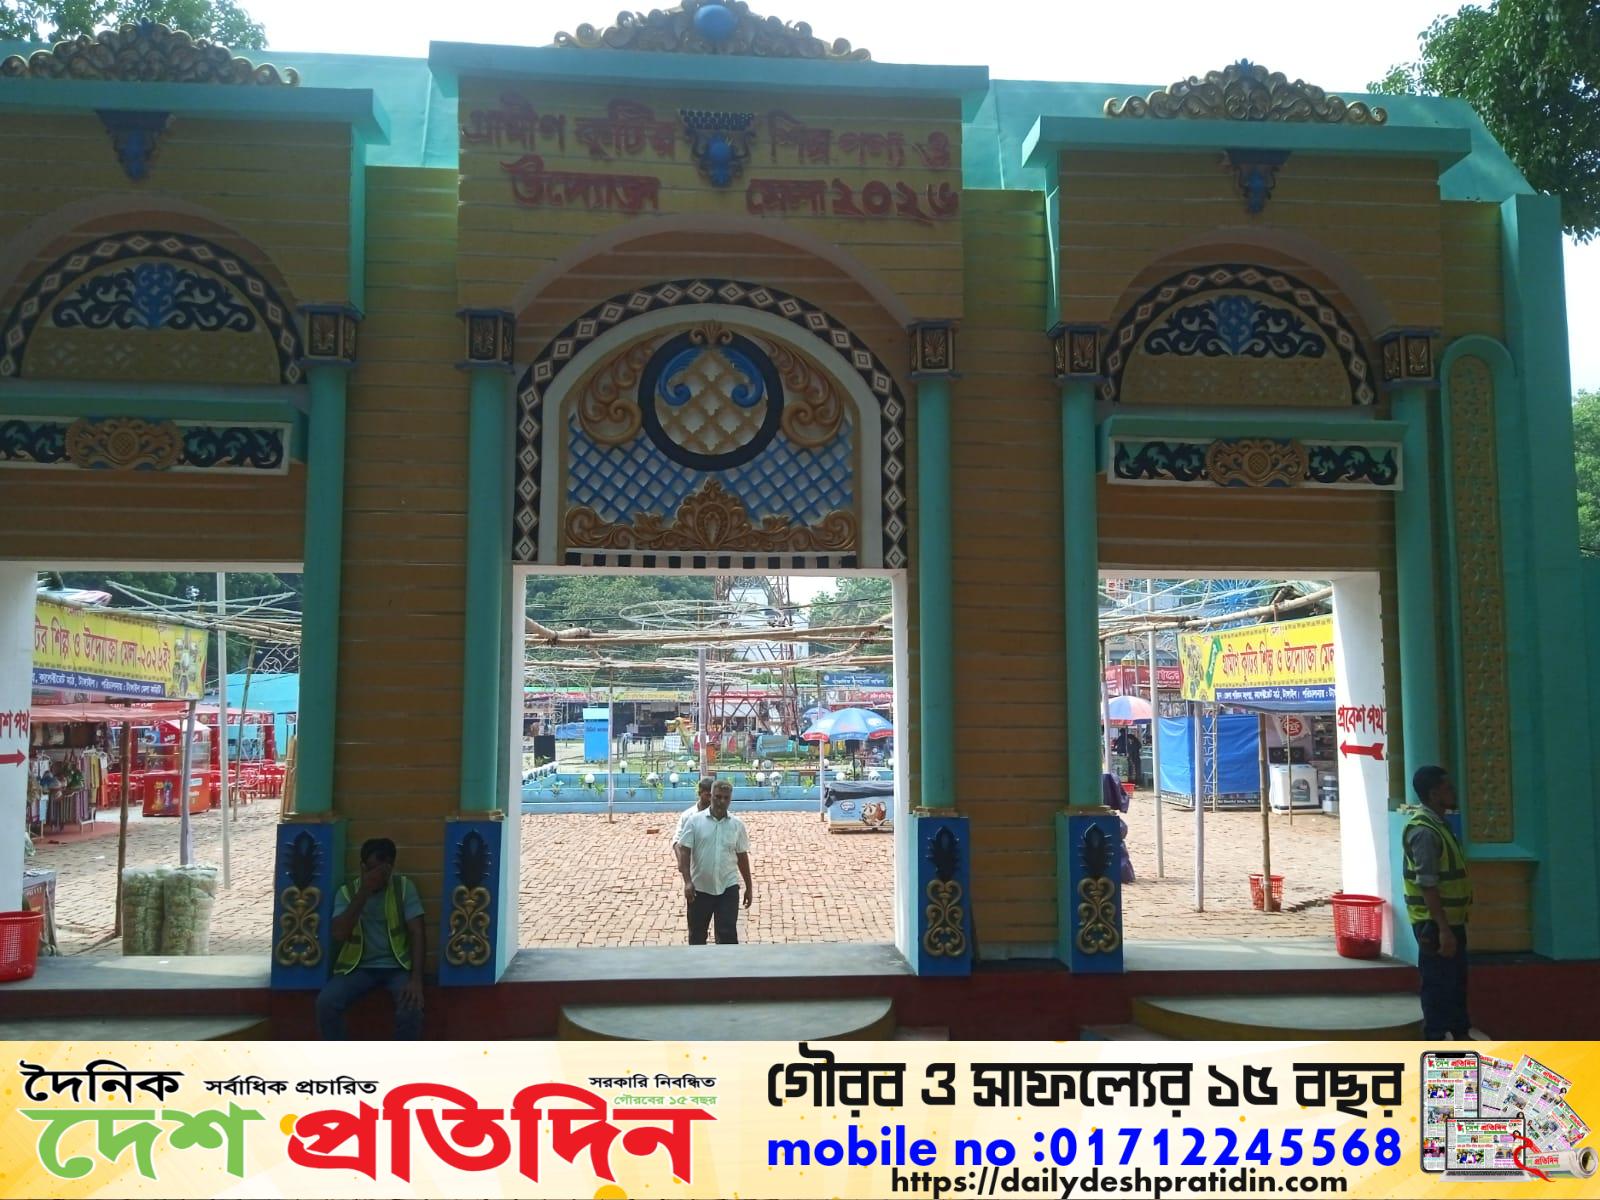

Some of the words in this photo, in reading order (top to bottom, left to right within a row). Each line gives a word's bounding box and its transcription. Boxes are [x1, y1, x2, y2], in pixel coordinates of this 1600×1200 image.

[14, 709, 30, 739] পথ
[1337, 704, 1366, 734] প্রবেশ
[1367, 704, 1385, 736] পথ
